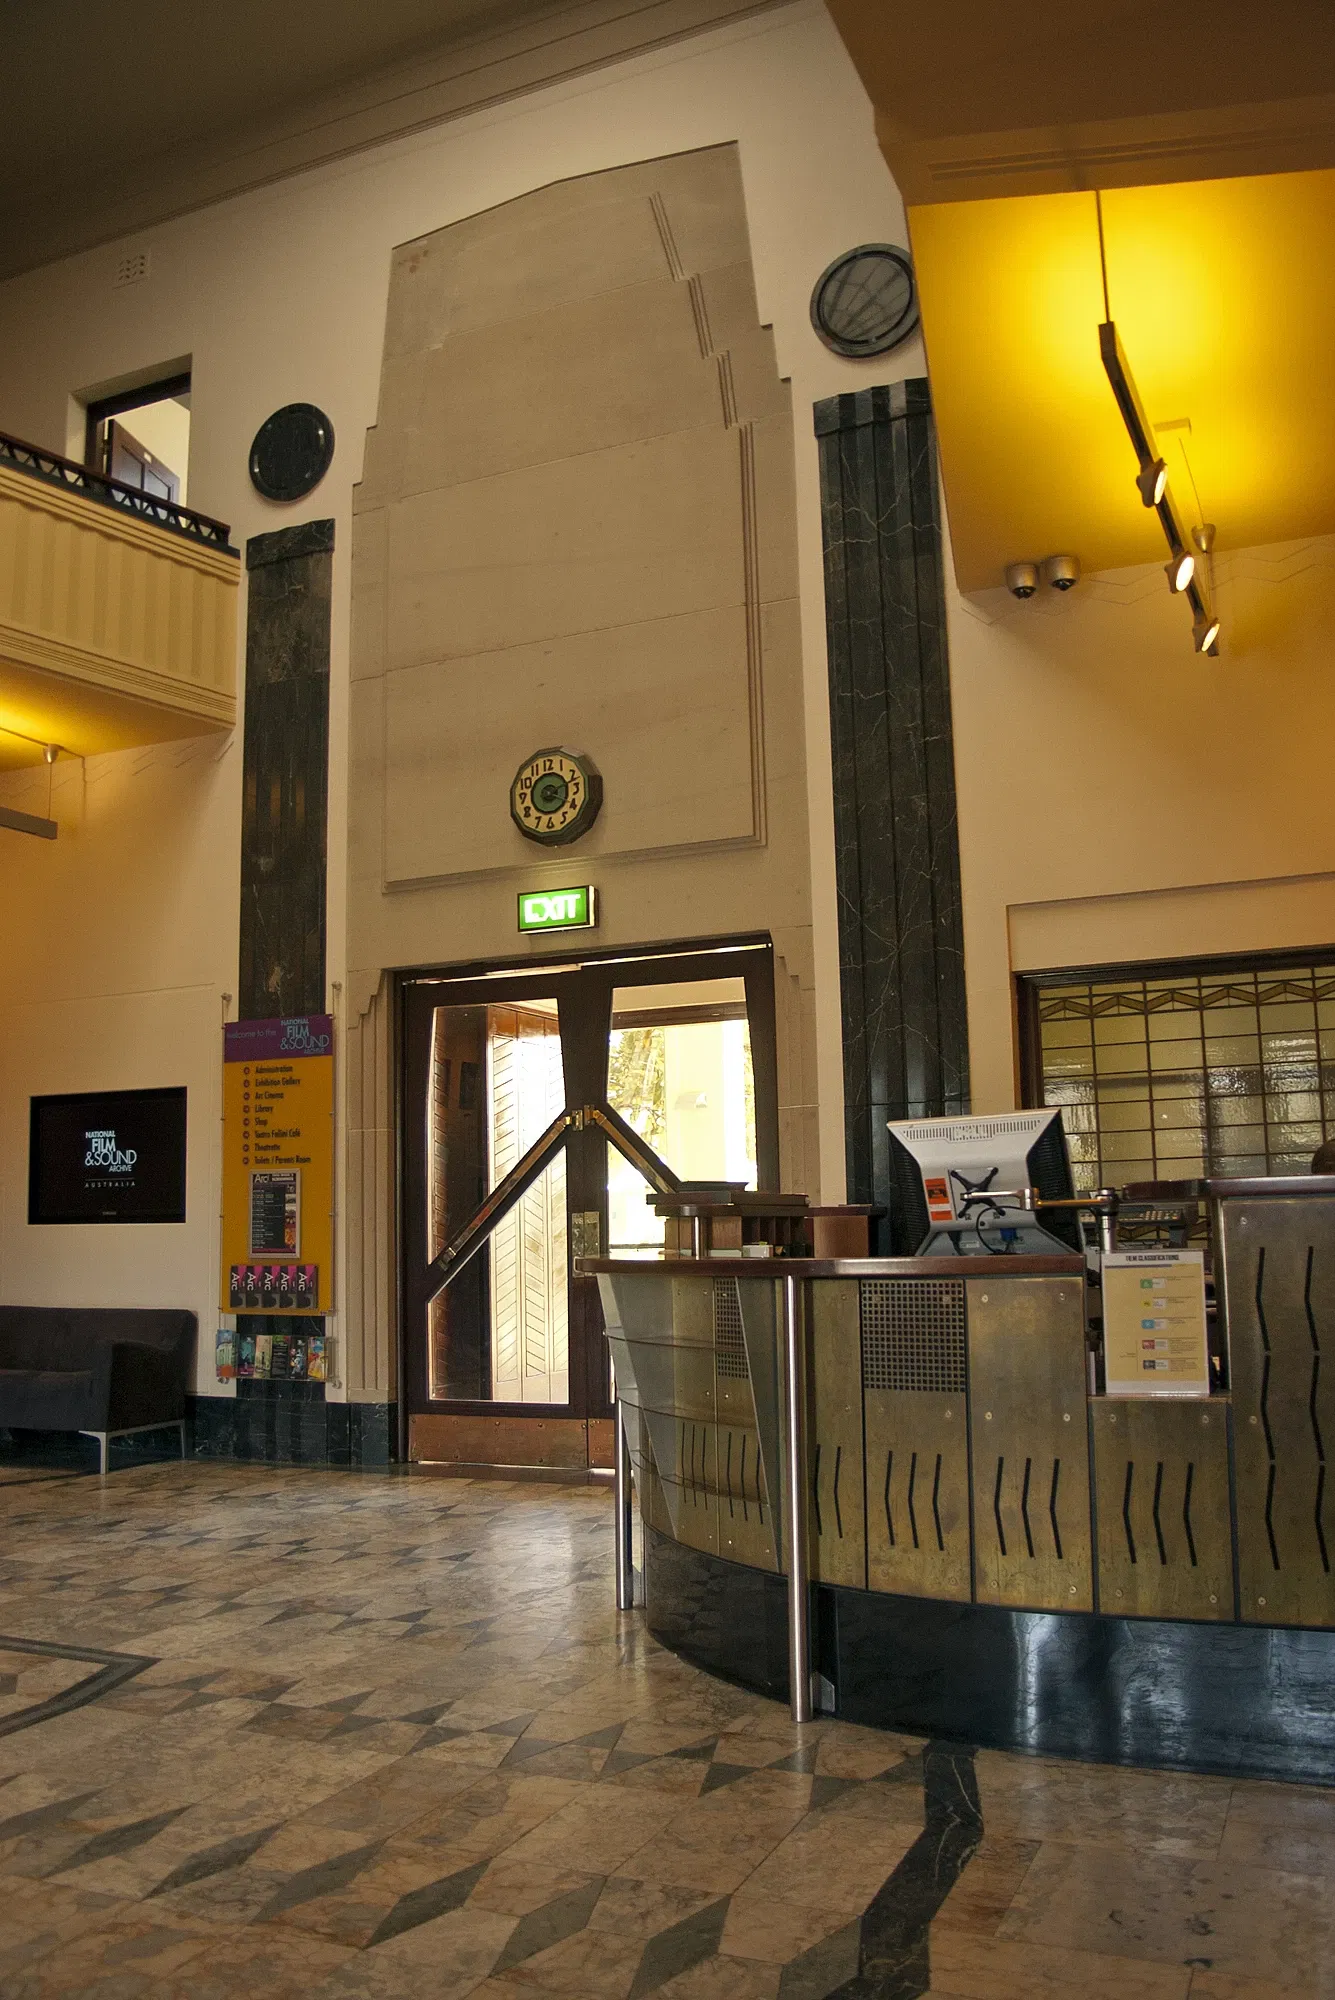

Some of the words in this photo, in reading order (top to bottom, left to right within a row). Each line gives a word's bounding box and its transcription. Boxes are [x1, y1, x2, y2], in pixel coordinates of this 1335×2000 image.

[531, 763, 539, 777] 11
[543, 758, 554, 772] 12
[569, 769, 577, 781] 2
[520, 776, 532, 790] 10
[572, 782, 580, 795] 3
[519, 792, 527, 805] 9
[569, 797, 578, 810] 4
[523, 805, 531, 818] 8
[560, 811, 568, 824] 5
[534, 815, 542, 829] 7
[546, 816, 555, 829] 6
[524, 894, 581, 923] EXIT
[281, 1018, 309, 1026] NATIONAL
[226, 1031, 256, 1039] welcome
[265, 1028, 277, 1036] the
[287, 1025, 310, 1038] FILM
[256, 1065, 293, 1073] Administration
[255, 1078, 280, 1087] Exhibition
[281, 1077, 301, 1086] Gallery
[264, 1091, 284, 1099] Cinema
[255, 1104, 273, 1113] Library
[255, 1117, 268, 1126] Shop
[92, 1138, 116, 1153] FILM
[295, 1154, 312, 1163] Room
[231, 1272, 241, 1291] Arc
[247, 1272, 257, 1291] Arc
[264, 1272, 274, 1291] Arc
[280, 1272, 290, 1291] Arc
[298, 1272, 308, 1291] Arc
